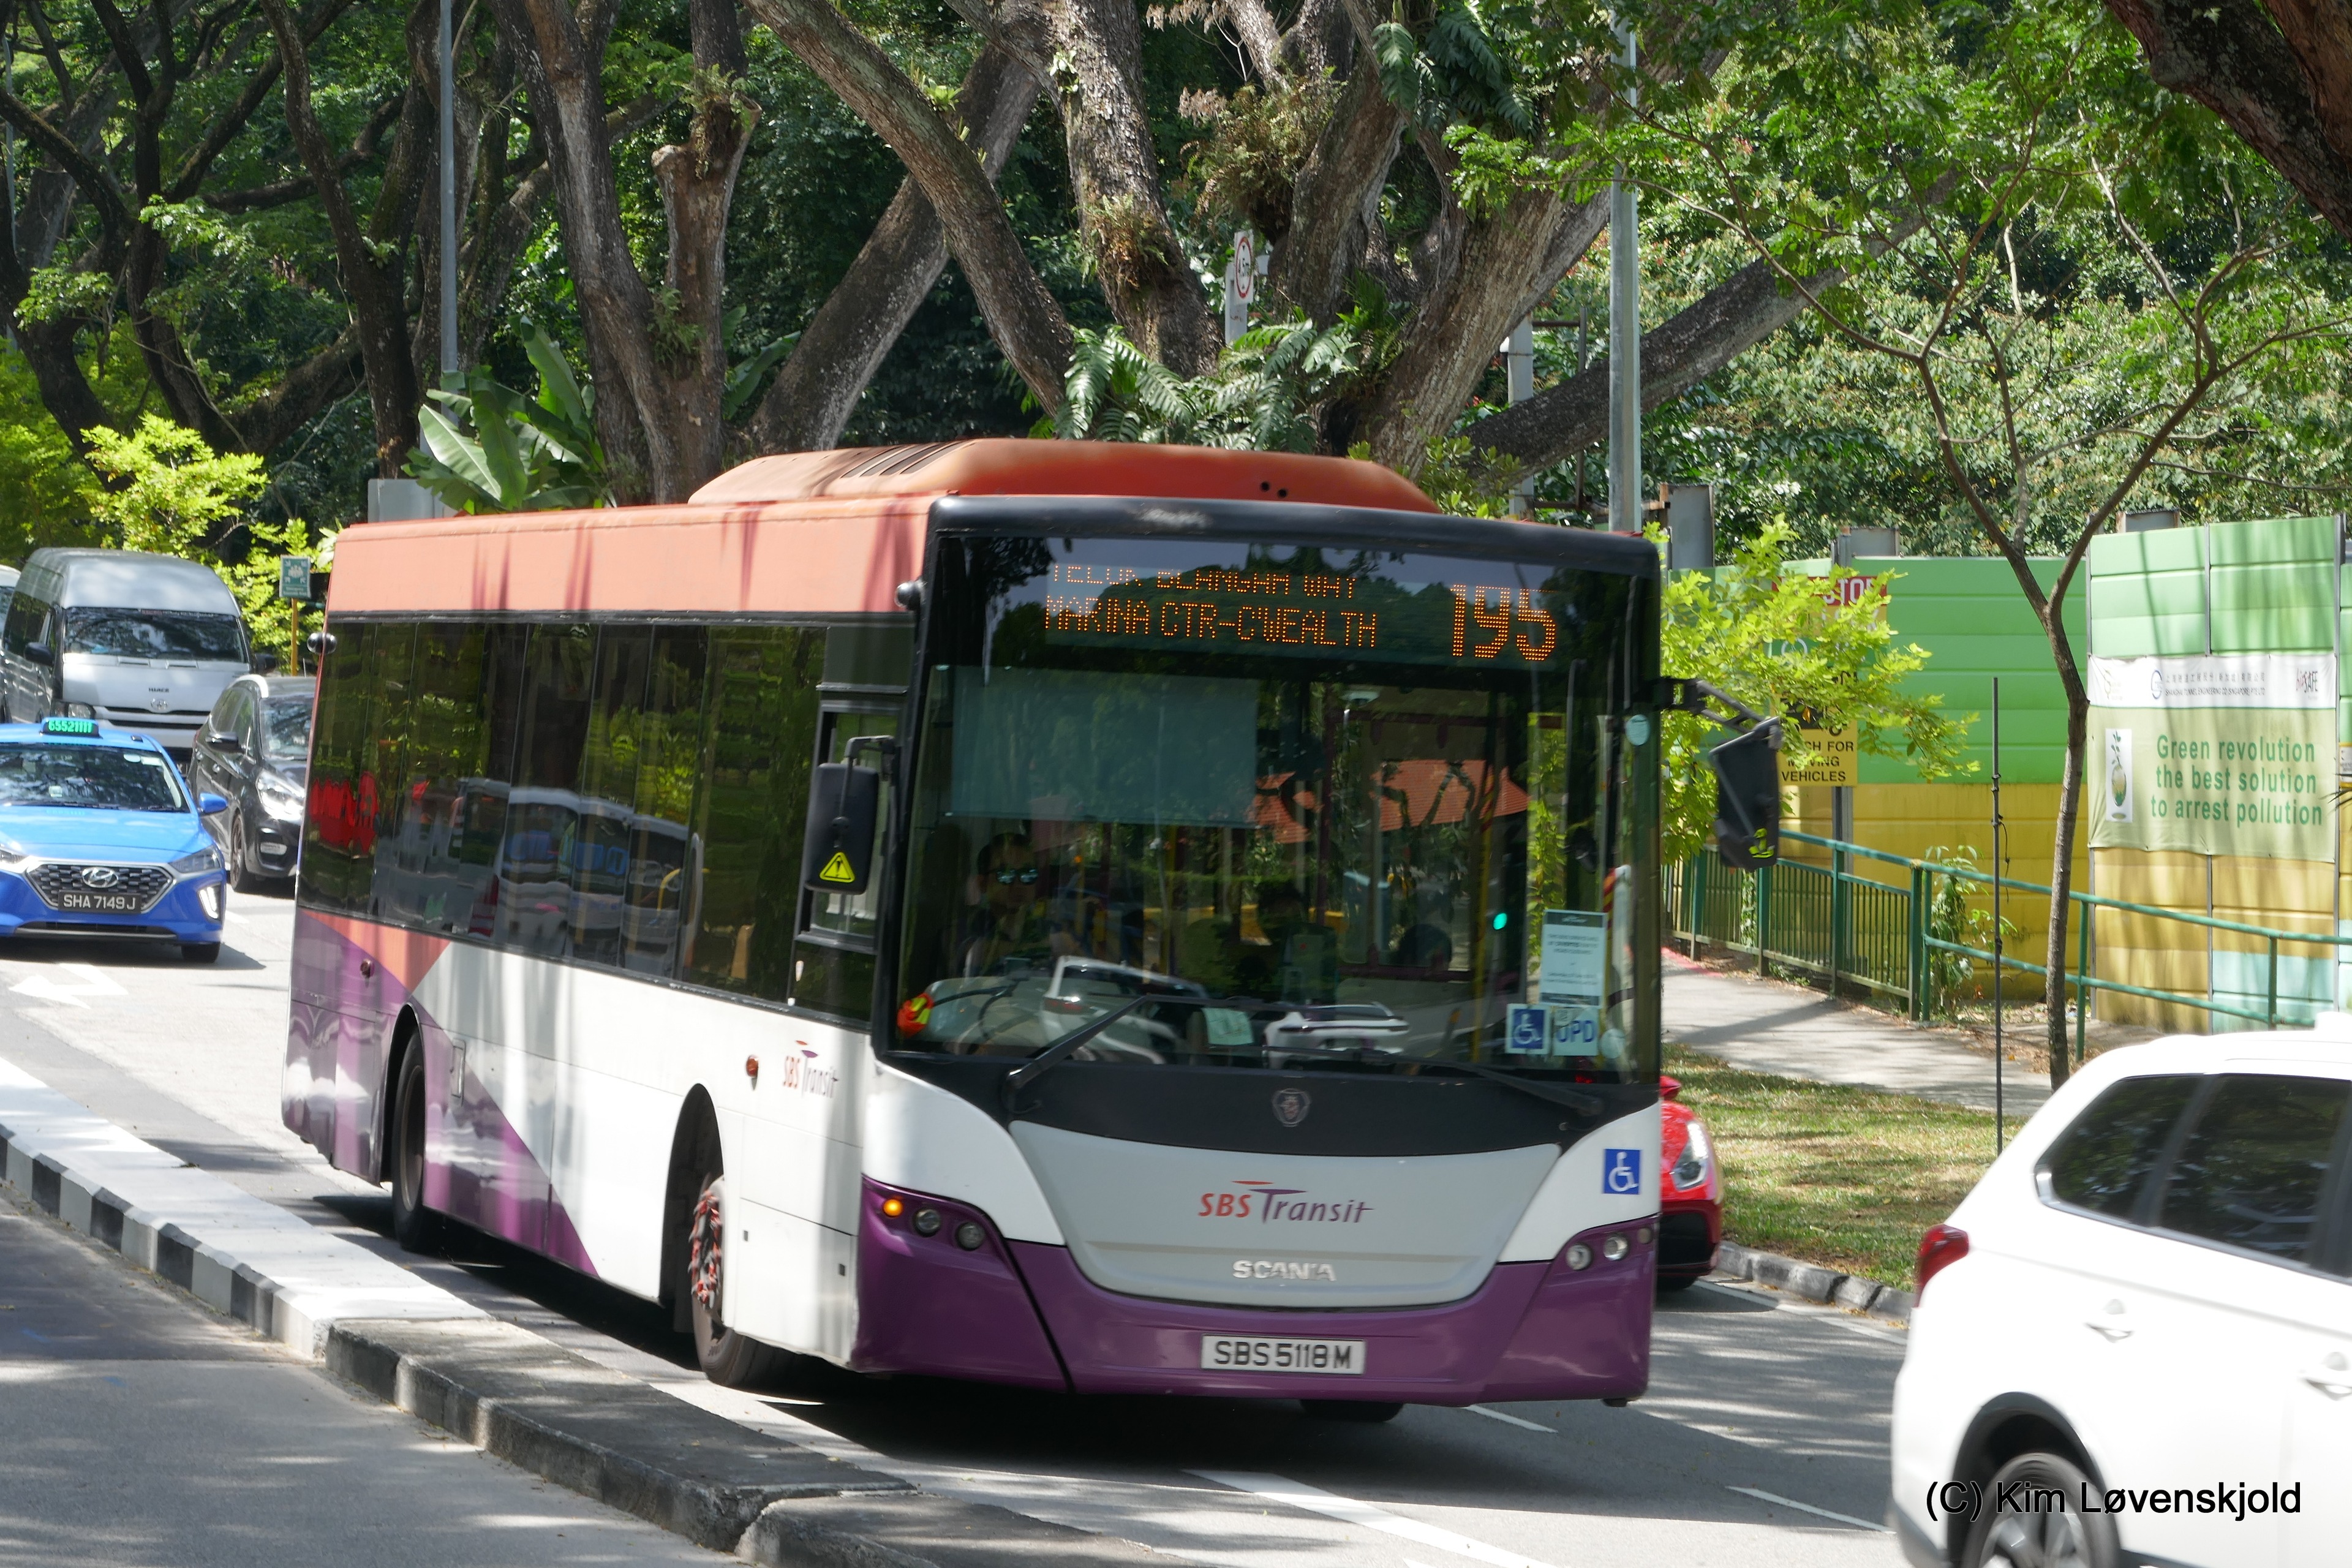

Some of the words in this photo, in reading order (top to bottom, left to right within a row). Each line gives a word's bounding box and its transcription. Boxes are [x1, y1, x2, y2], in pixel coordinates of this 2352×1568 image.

[1045, 595, 1150, 635] MARINA
[1450, 584, 1558, 661] 195
[48, 720, 93, 733] 65521111
[1828, 741, 1853, 752] FOR
[2157, 734, 2210, 759] Green
[2218, 736, 2315, 763] revolution
[1782, 771, 1846, 782] VEHICLES
[2156, 764, 2183, 788] the
[2192, 765, 2230, 790] best
[2238, 767, 2316, 794] solution
[2151, 794, 2167, 818] to
[2176, 798, 2229, 821] arrest
[2237, 798, 2322, 828] pollution
[63, 894, 91, 908] SHA
[783, 1055, 801, 1089] SBS
[801, 1050, 839, 1098] Transit
[1198, 1193, 1252, 1218] SBS
[1248, 1189, 1374, 1224] Transit
[1232, 1260, 1336, 1281] SCANIA
